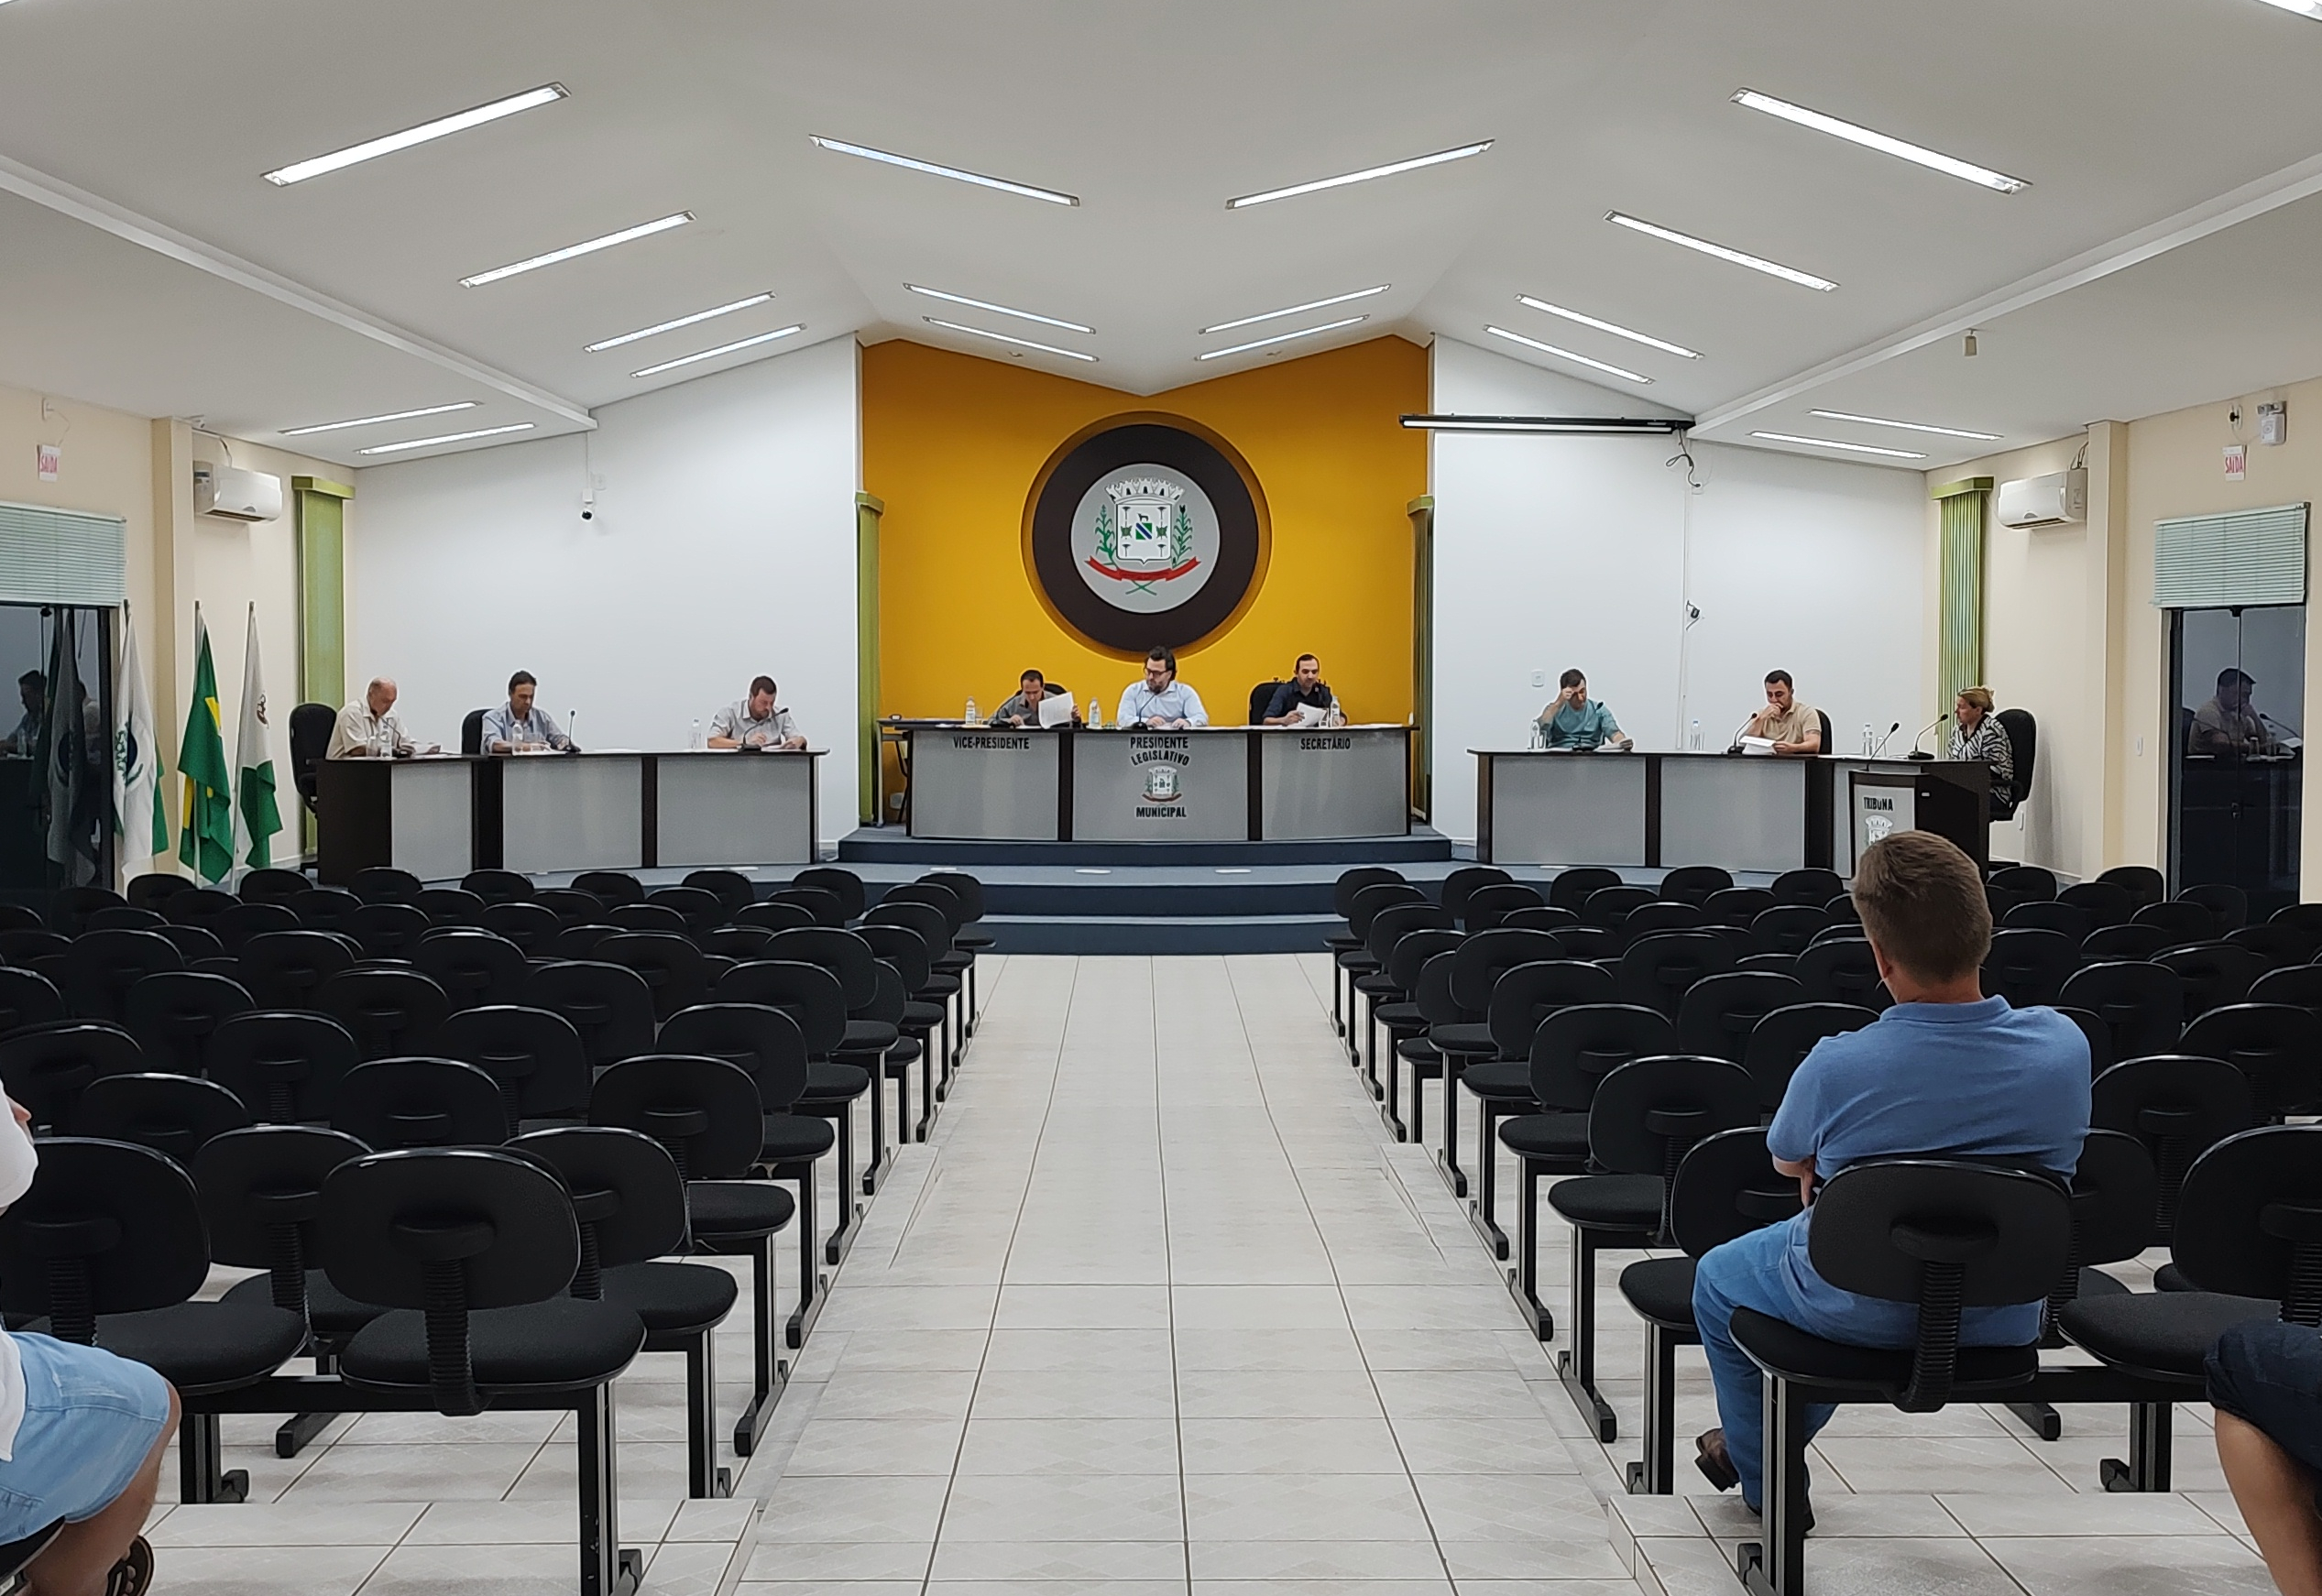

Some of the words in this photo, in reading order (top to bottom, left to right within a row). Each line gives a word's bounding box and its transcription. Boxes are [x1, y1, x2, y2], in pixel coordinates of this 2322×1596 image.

[953, 736, 1030, 749] VICE-PRESIDENTE
[1130, 737, 1188, 749] PRESIDENTE
[1130, 749, 1189, 766] LEGISLATIVO
[1864, 796, 1893, 811] TRIBUNA
[1136, 806, 1187, 818] MUNICIPAL
